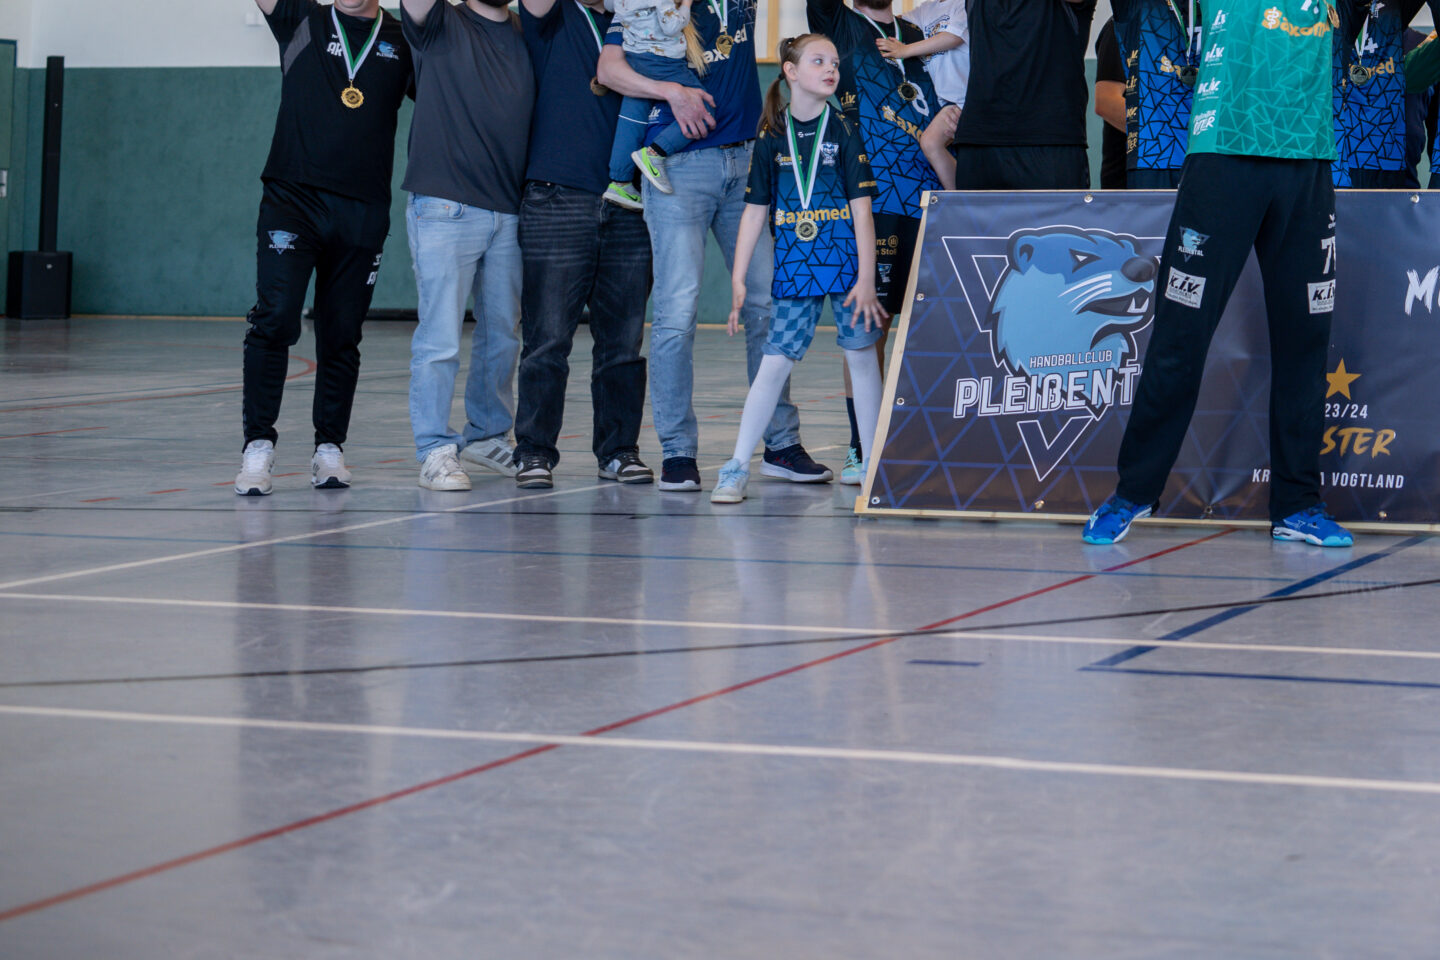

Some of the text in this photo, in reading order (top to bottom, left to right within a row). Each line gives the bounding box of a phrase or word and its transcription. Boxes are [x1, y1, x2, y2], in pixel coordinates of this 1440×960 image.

[1029, 349, 1113, 369] HANDBALLCLUB
[1325, 402, 1369, 419] 23/24
[1319, 425, 1397, 459] STER
[1331, 471, 1405, 489] VOGTLAND
